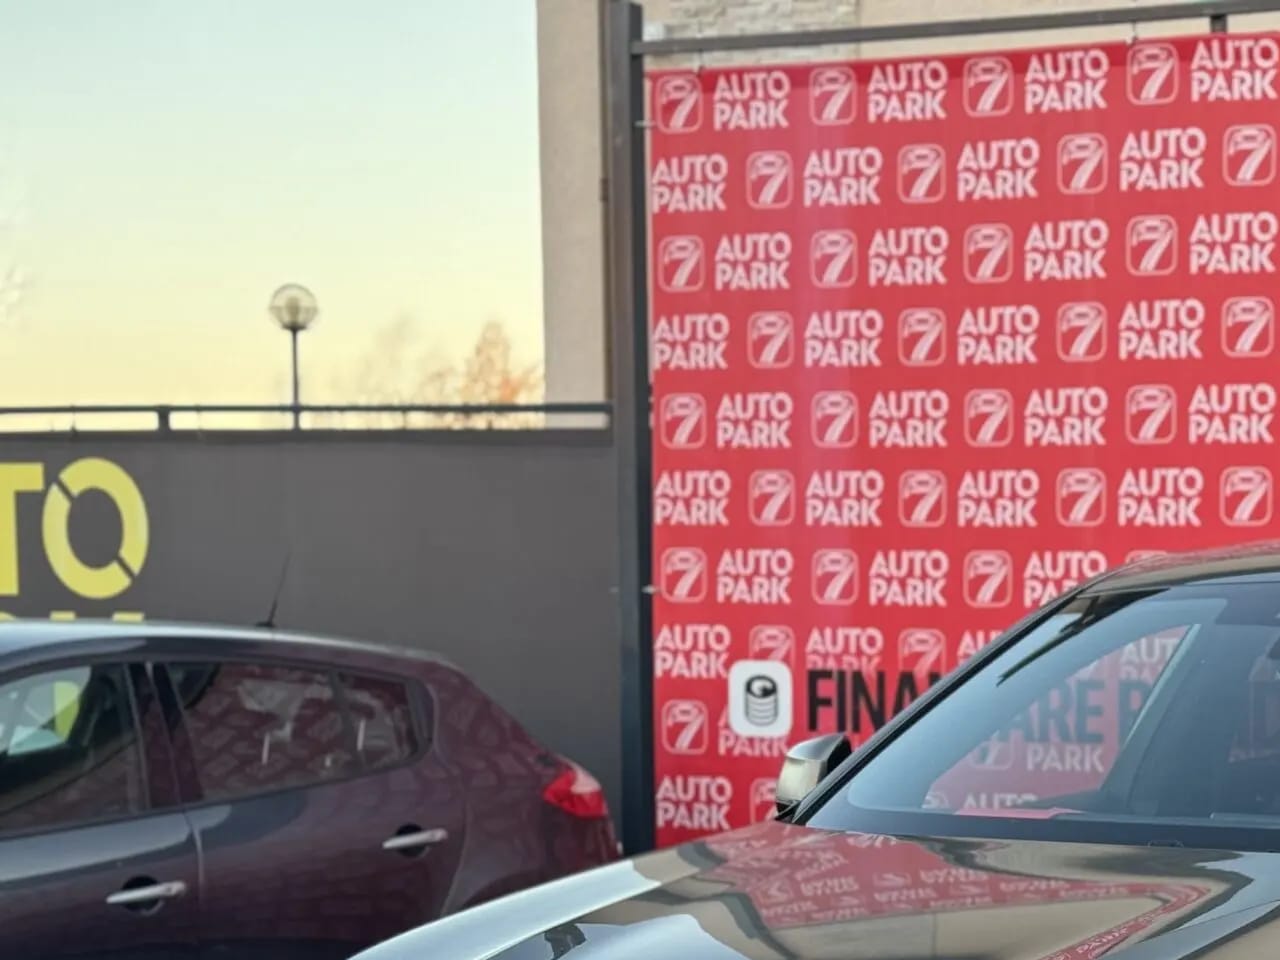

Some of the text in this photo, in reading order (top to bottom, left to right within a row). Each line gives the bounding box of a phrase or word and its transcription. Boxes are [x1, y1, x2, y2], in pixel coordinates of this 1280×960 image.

[1025, 50, 1109, 81] AUTO
[1191, 39, 1279, 70] AUTO
[714, 72, 790, 101] AUTO
[869, 61, 947, 94] AUTO
[1190, 69, 1278, 102] PARK
[868, 90, 946, 122] PARK
[1025, 79, 1107, 112] PARK
[714, 100, 789, 130] PARK
[958, 139, 1039, 170] AUTO
[1120, 128, 1206, 160] AUTO
[651, 154, 728, 186] AUTO
[804, 148, 882, 179] AUTO
[1120, 156, 1205, 191] PARK
[651, 182, 726, 213] PARK
[804, 176, 880, 207] PARK
[958, 168, 1038, 201] PARK
[869, 226, 949, 258] AUTO
[1025, 219, 1108, 251] AUTO
[1190, 211, 1278, 245] AUTO
[715, 233, 791, 263] AUTO
[1189, 241, 1276, 275] PARK
[715, 261, 790, 291] PARK
[869, 255, 946, 286] PARK
[1024, 248, 1106, 281] PARK
[651, 313, 729, 344] AUTO
[804, 310, 882, 341] AUTO
[958, 305, 1039, 338] AUTO
[1119, 299, 1205, 331] AUTO
[652, 341, 728, 370] PARK
[805, 338, 881, 368] PARK
[958, 334, 1038, 366] PARK
[1119, 328, 1202, 361] PARK
[716, 392, 792, 421] AUTO
[870, 390, 949, 420] AUTO
[1025, 388, 1108, 418] AUTO
[1190, 384, 1276, 415] AUTO
[716, 419, 790, 449] PARK
[869, 418, 948, 448] PARK
[1024, 415, 1106, 446] PARK
[1189, 411, 1275, 444] PARK
[654, 470, 731, 500] AUTO
[806, 470, 884, 500] AUTO
[958, 470, 1039, 499] AUTO
[1118, 468, 1204, 499] AUTO
[654, 498, 729, 526] PARK
[805, 498, 881, 526] PARK
[958, 496, 1038, 528] PARK
[1118, 496, 1202, 528] PARK
[716, 550, 793, 579] AUTO
[869, 551, 949, 580] AUTO
[1024, 550, 1107, 579] AUTO
[717, 575, 792, 603] PARK
[869, 577, 945, 606] PARK
[654, 624, 730, 651] AUTO
[806, 626, 883, 654] AUTO
[654, 651, 728, 678] PARK
[1026, 746, 1104, 772] PARK
[656, 776, 732, 801] AUTO
[656, 802, 730, 830] PARK
